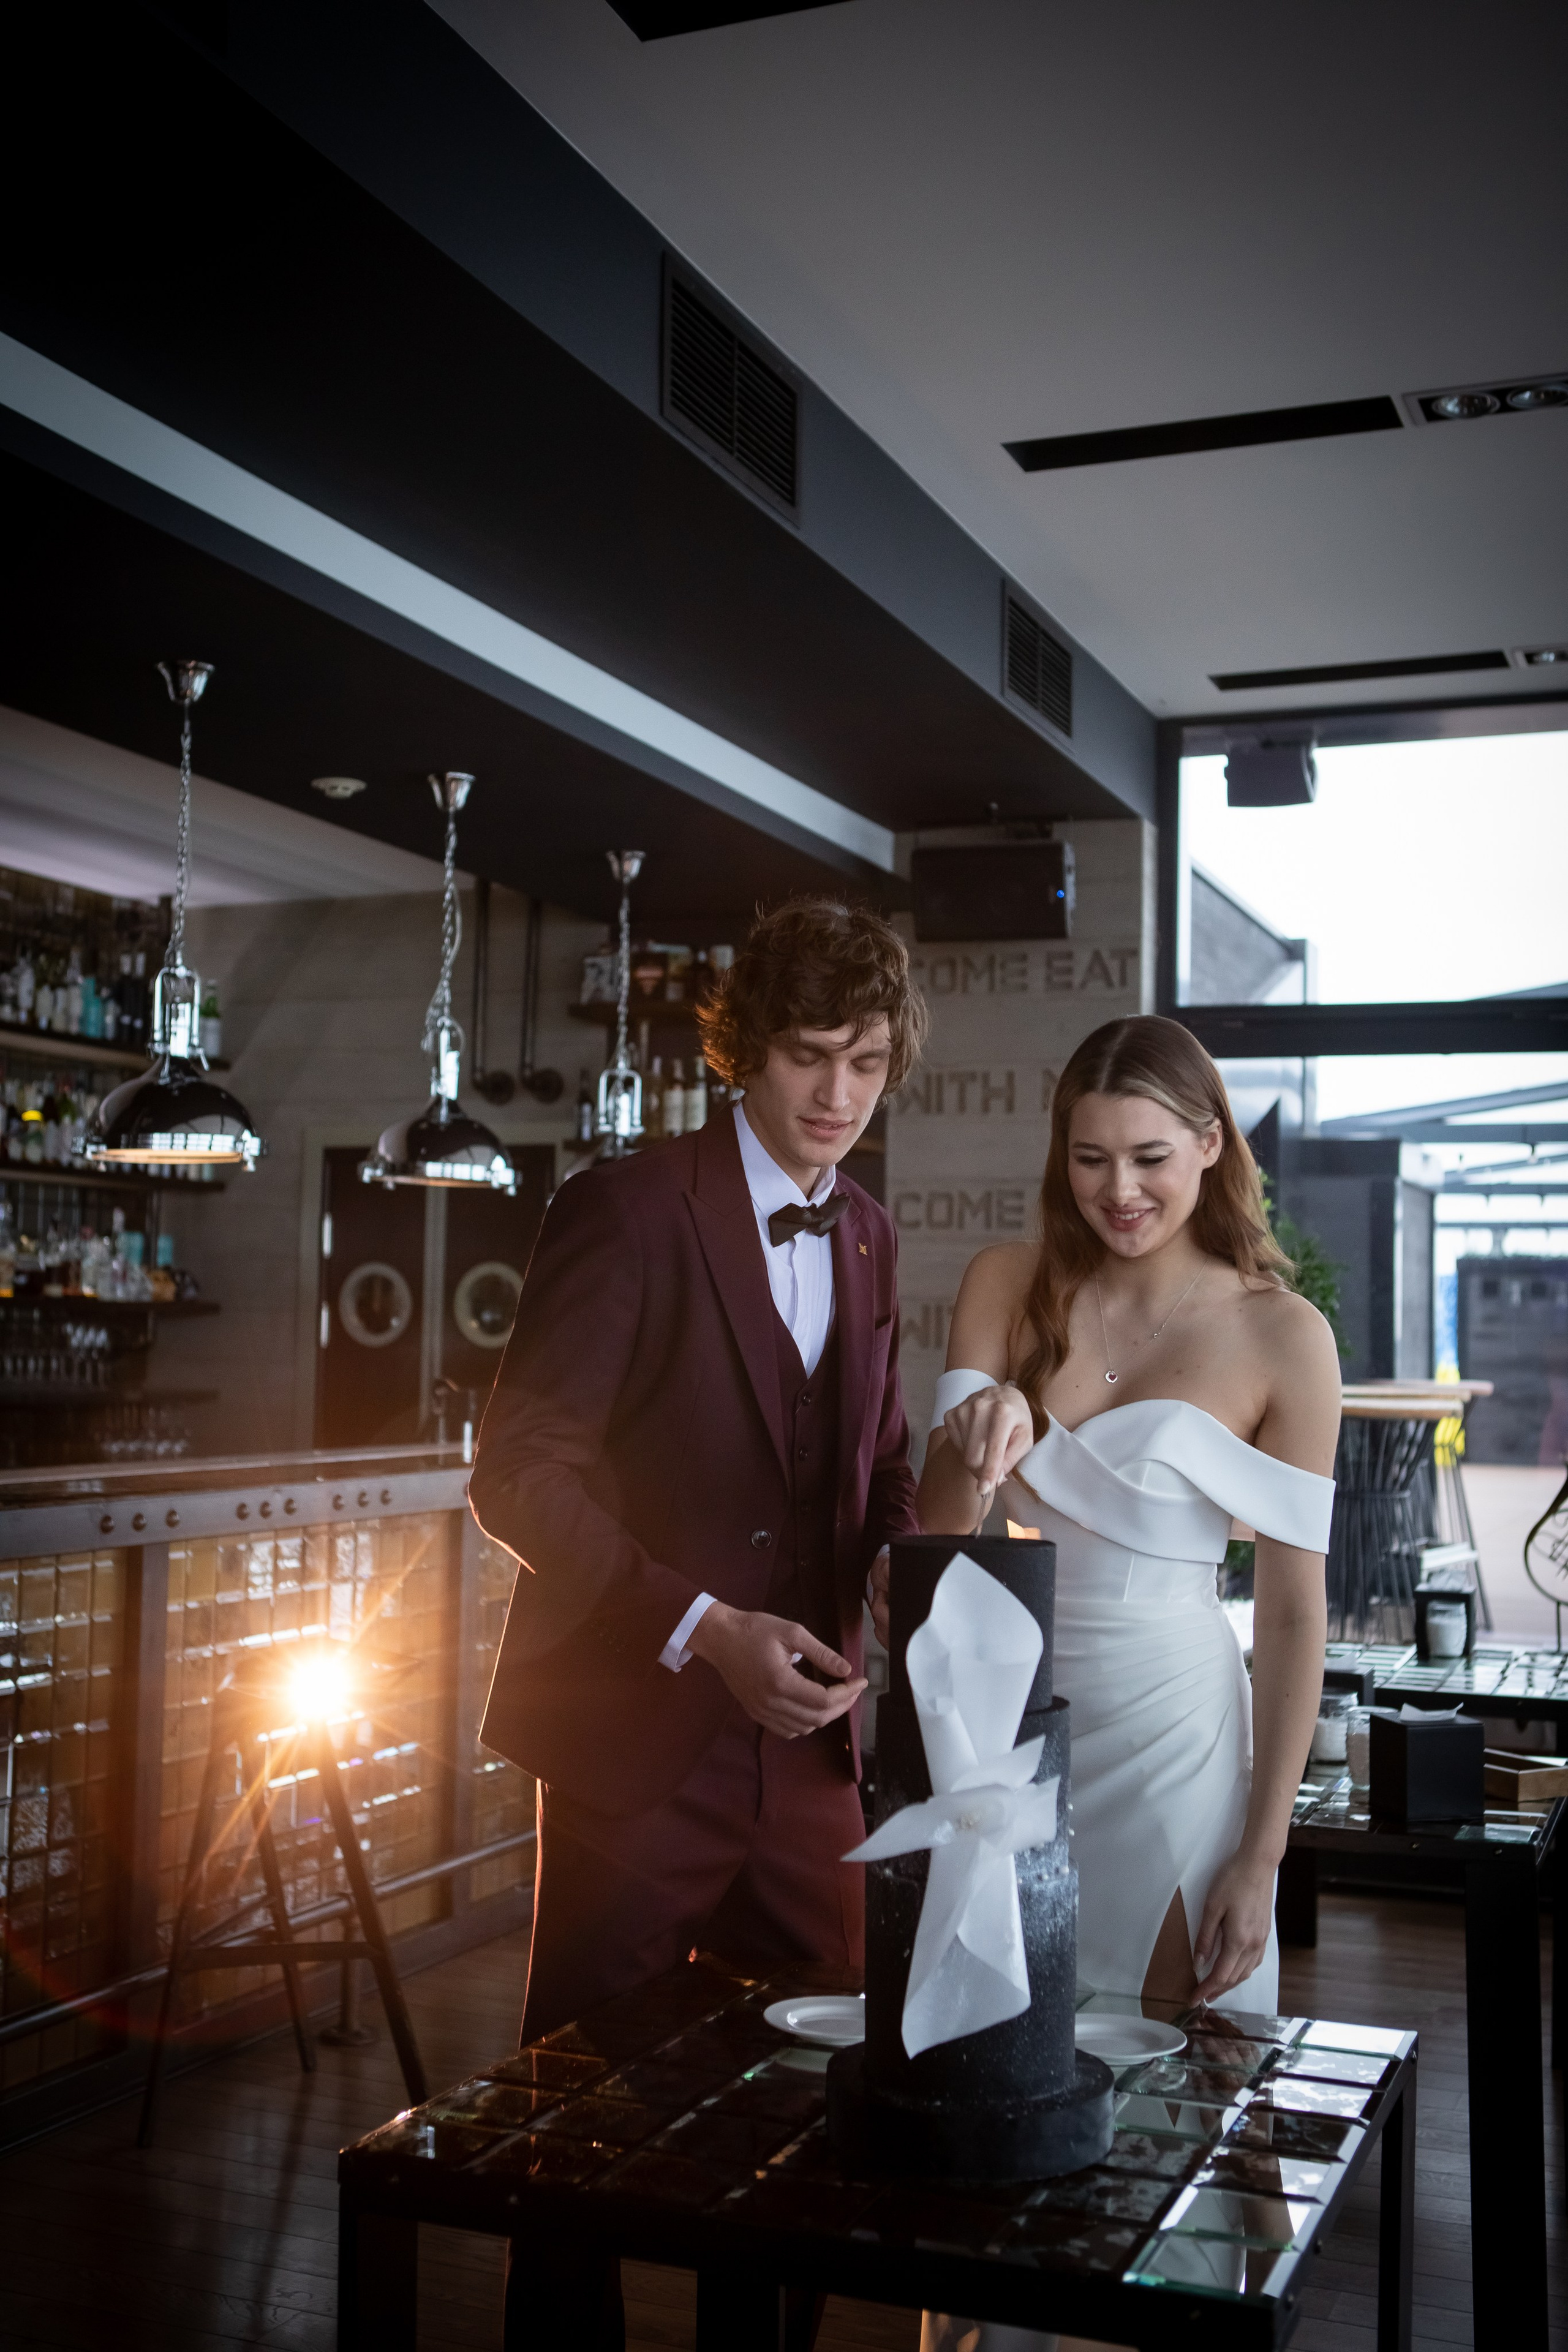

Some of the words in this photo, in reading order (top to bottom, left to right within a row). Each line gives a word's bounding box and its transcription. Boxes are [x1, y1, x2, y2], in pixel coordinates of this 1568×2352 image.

[1044, 948, 1140, 991] EAT
[897, 1069, 1015, 1114] WITH
[893, 1191, 1025, 1229] COME
